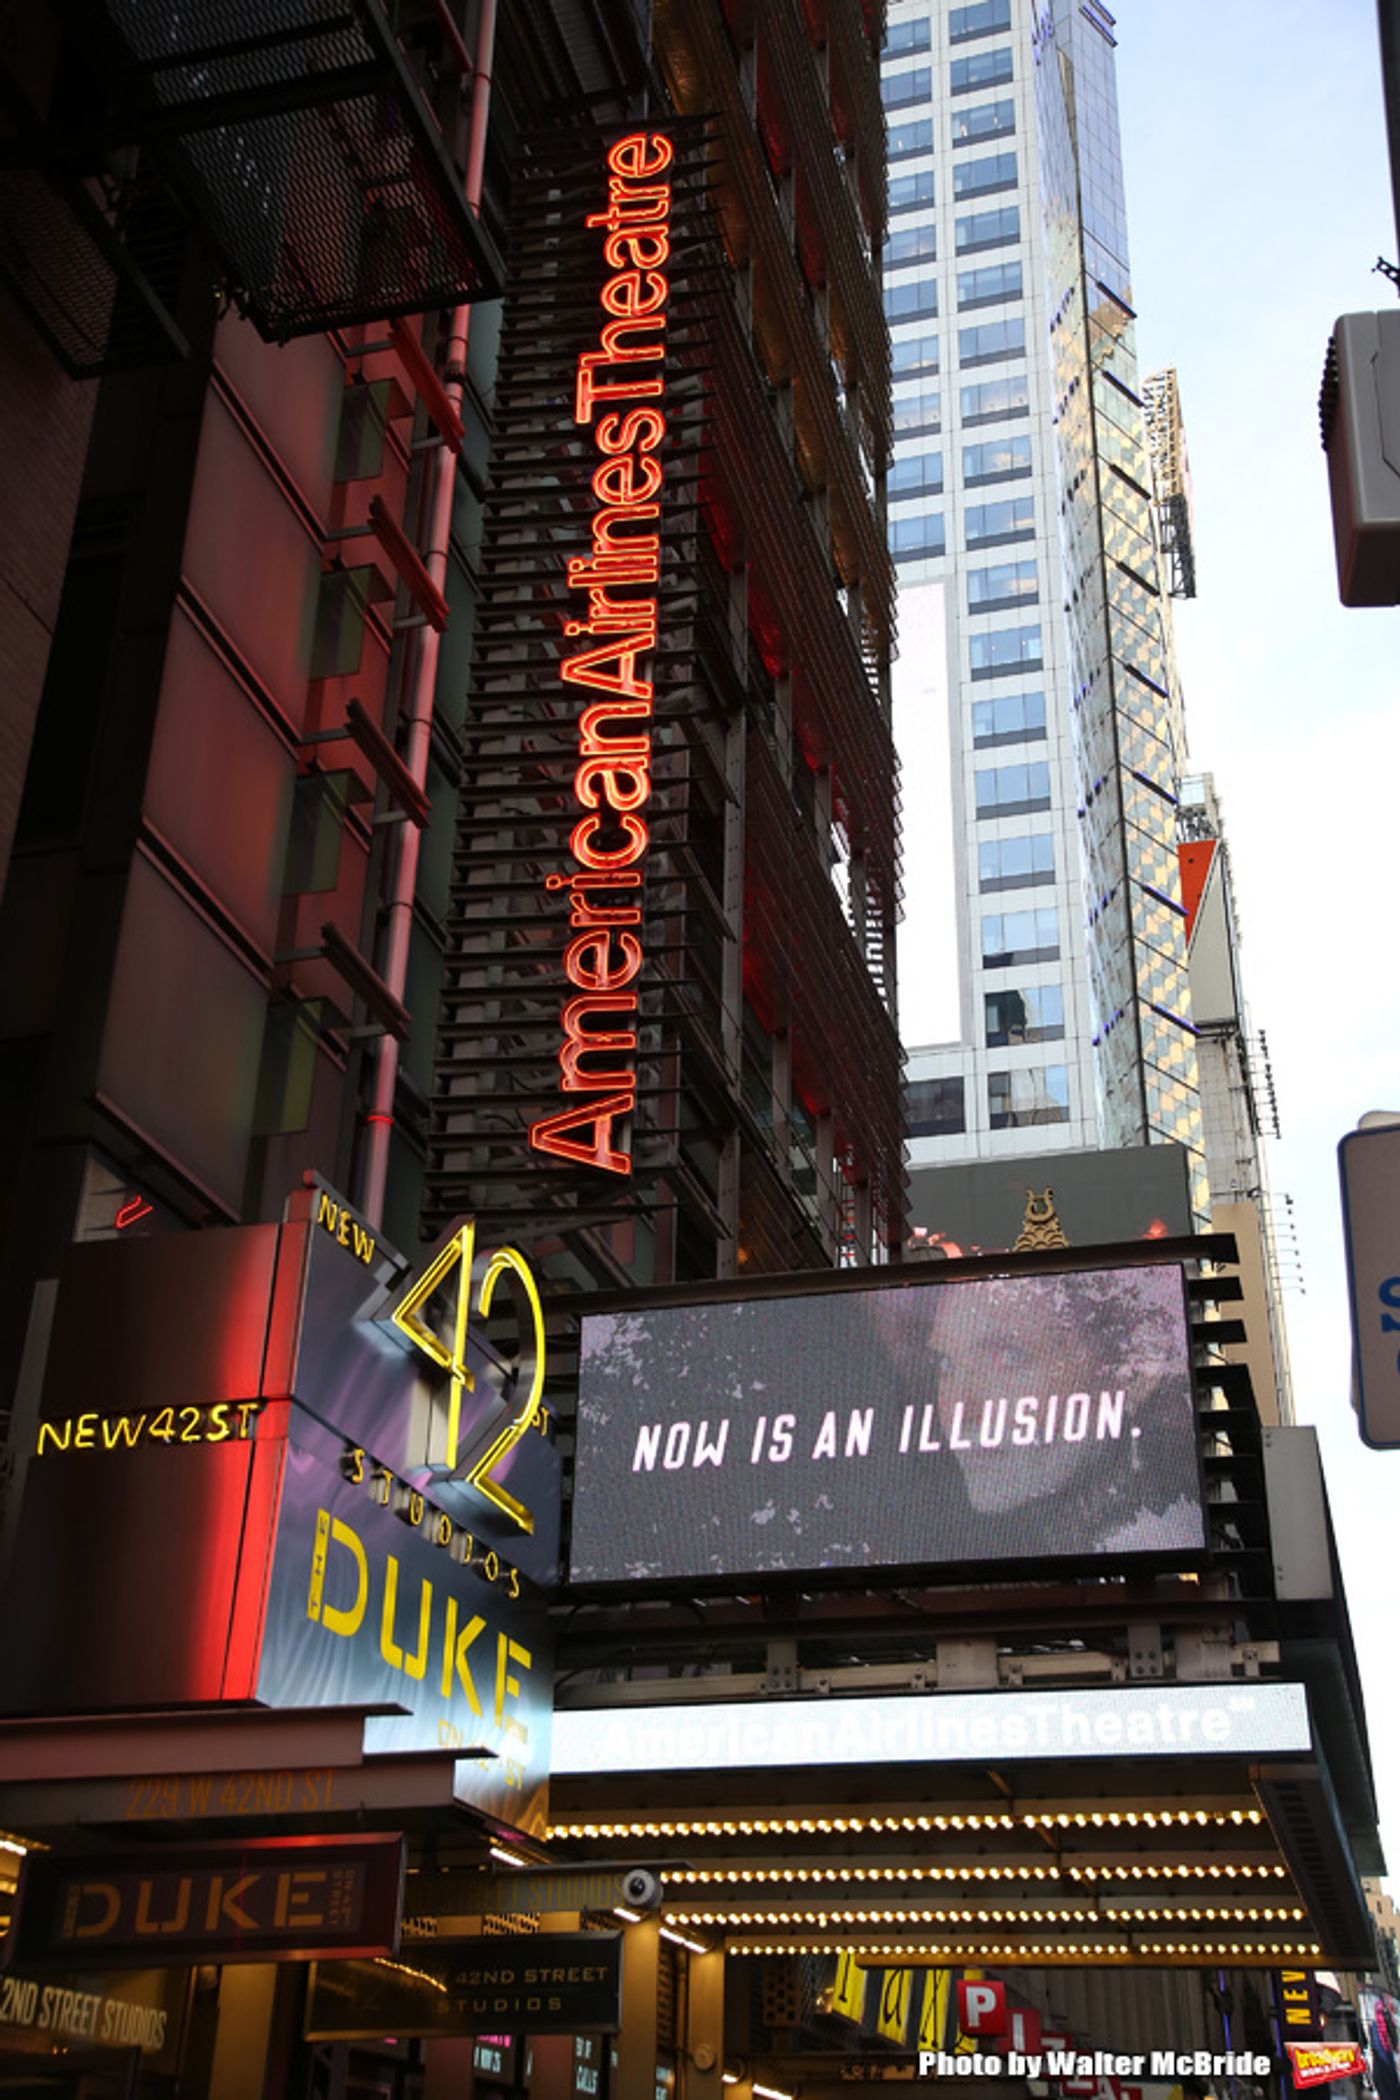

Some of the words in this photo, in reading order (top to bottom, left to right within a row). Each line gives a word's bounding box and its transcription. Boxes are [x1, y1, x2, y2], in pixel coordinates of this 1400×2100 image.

[317, 1194, 375, 1265] NEW
[391, 1218, 546, 1536] 42
[632, 1419, 729, 1472] NOW
[751, 1414, 796, 1464] IS
[812, 1407, 874, 1460] AN
[898, 1390, 1143, 1454] ILLUSION.
[307, 1508, 532, 1744] DUKE
[126, 1775, 180, 1818] 229
[190, 1774, 213, 1817] W
[219, 1770, 294, 1814] 42ND
[62, 1871, 327, 1938] DUKE
[437, 1997, 562, 2014] STUDIOS
[456, 1969, 515, 1985] 42ND
[524, 1966, 608, 1983] STREET
[0, 1976, 39, 2026] 2ND
[38, 1985, 102, 2036] STREET
[101, 1998, 168, 2050] STUDIOS
